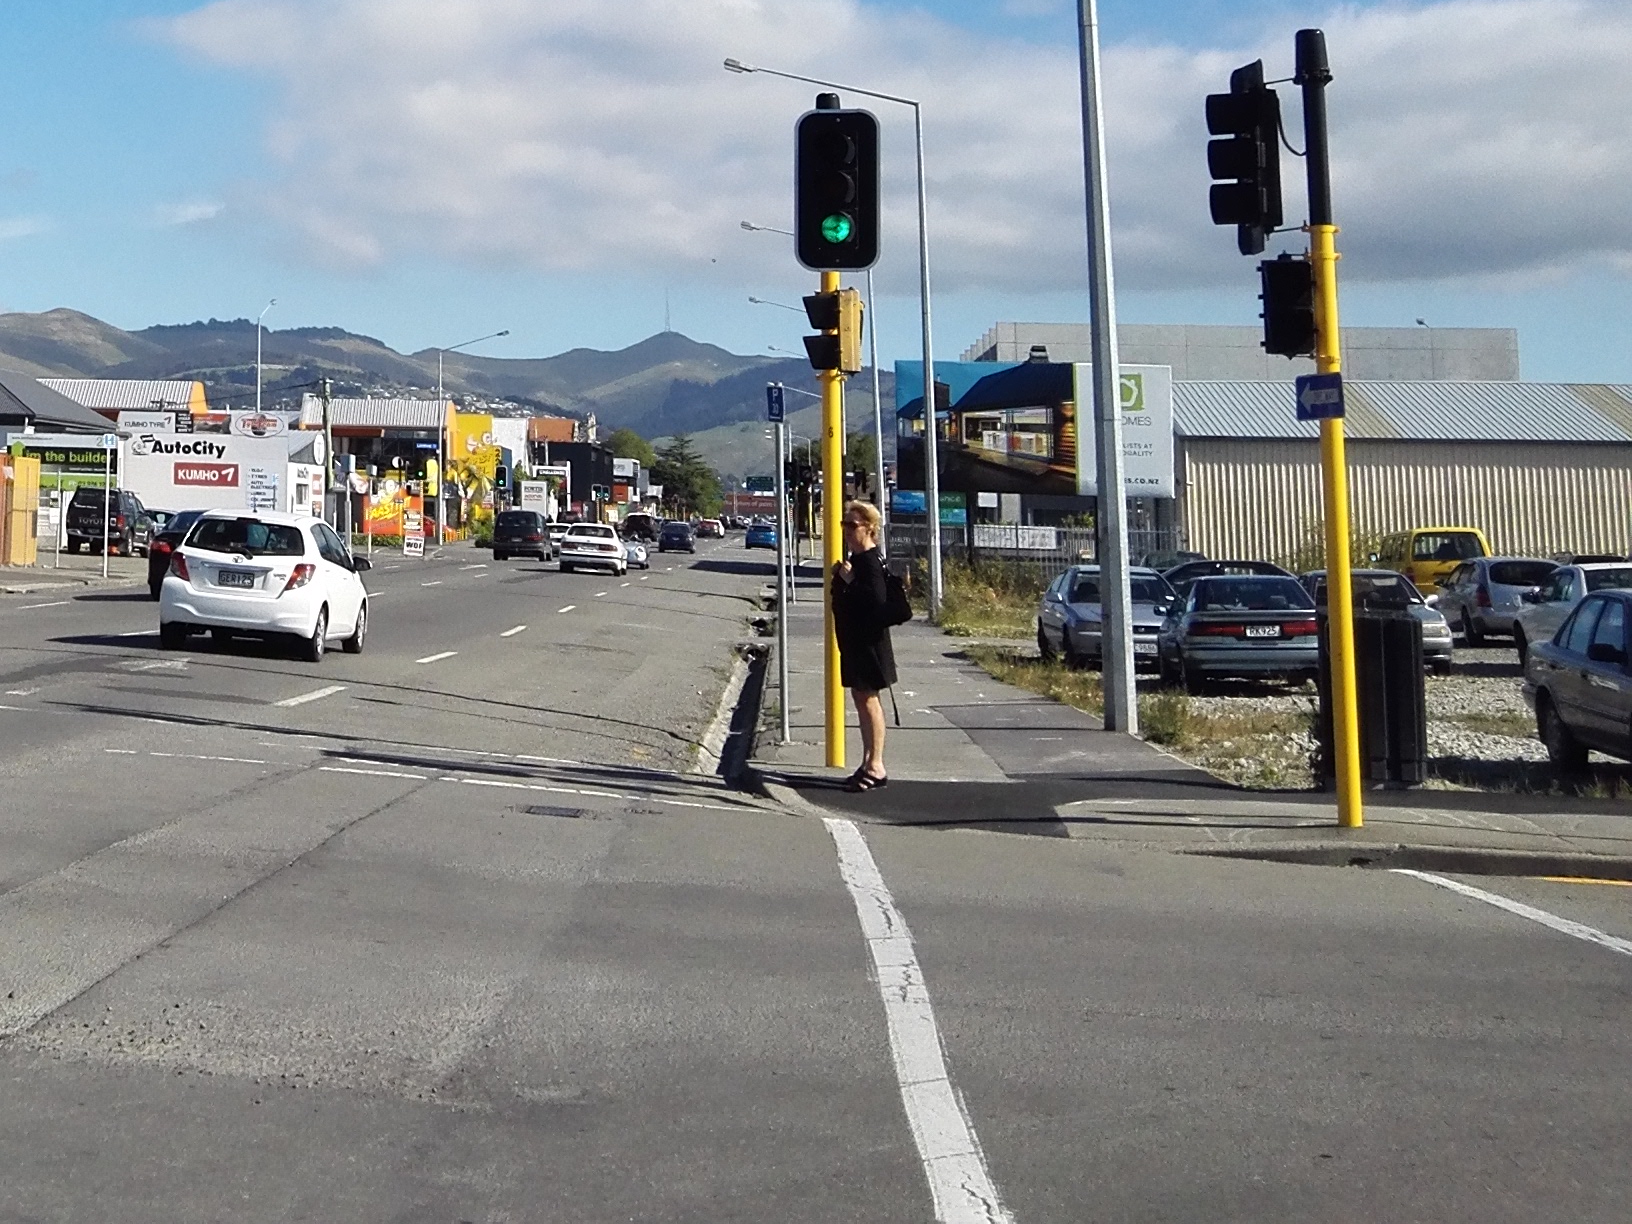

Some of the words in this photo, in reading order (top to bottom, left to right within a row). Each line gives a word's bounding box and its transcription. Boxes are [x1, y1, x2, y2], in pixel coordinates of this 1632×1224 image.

[1121, 416, 1152, 427] OMES
[151, 440, 226, 458] AutoCity
[45, 451, 65, 462] the
[69, 451, 114, 463] builde
[177, 469, 219, 481] KUMHO
